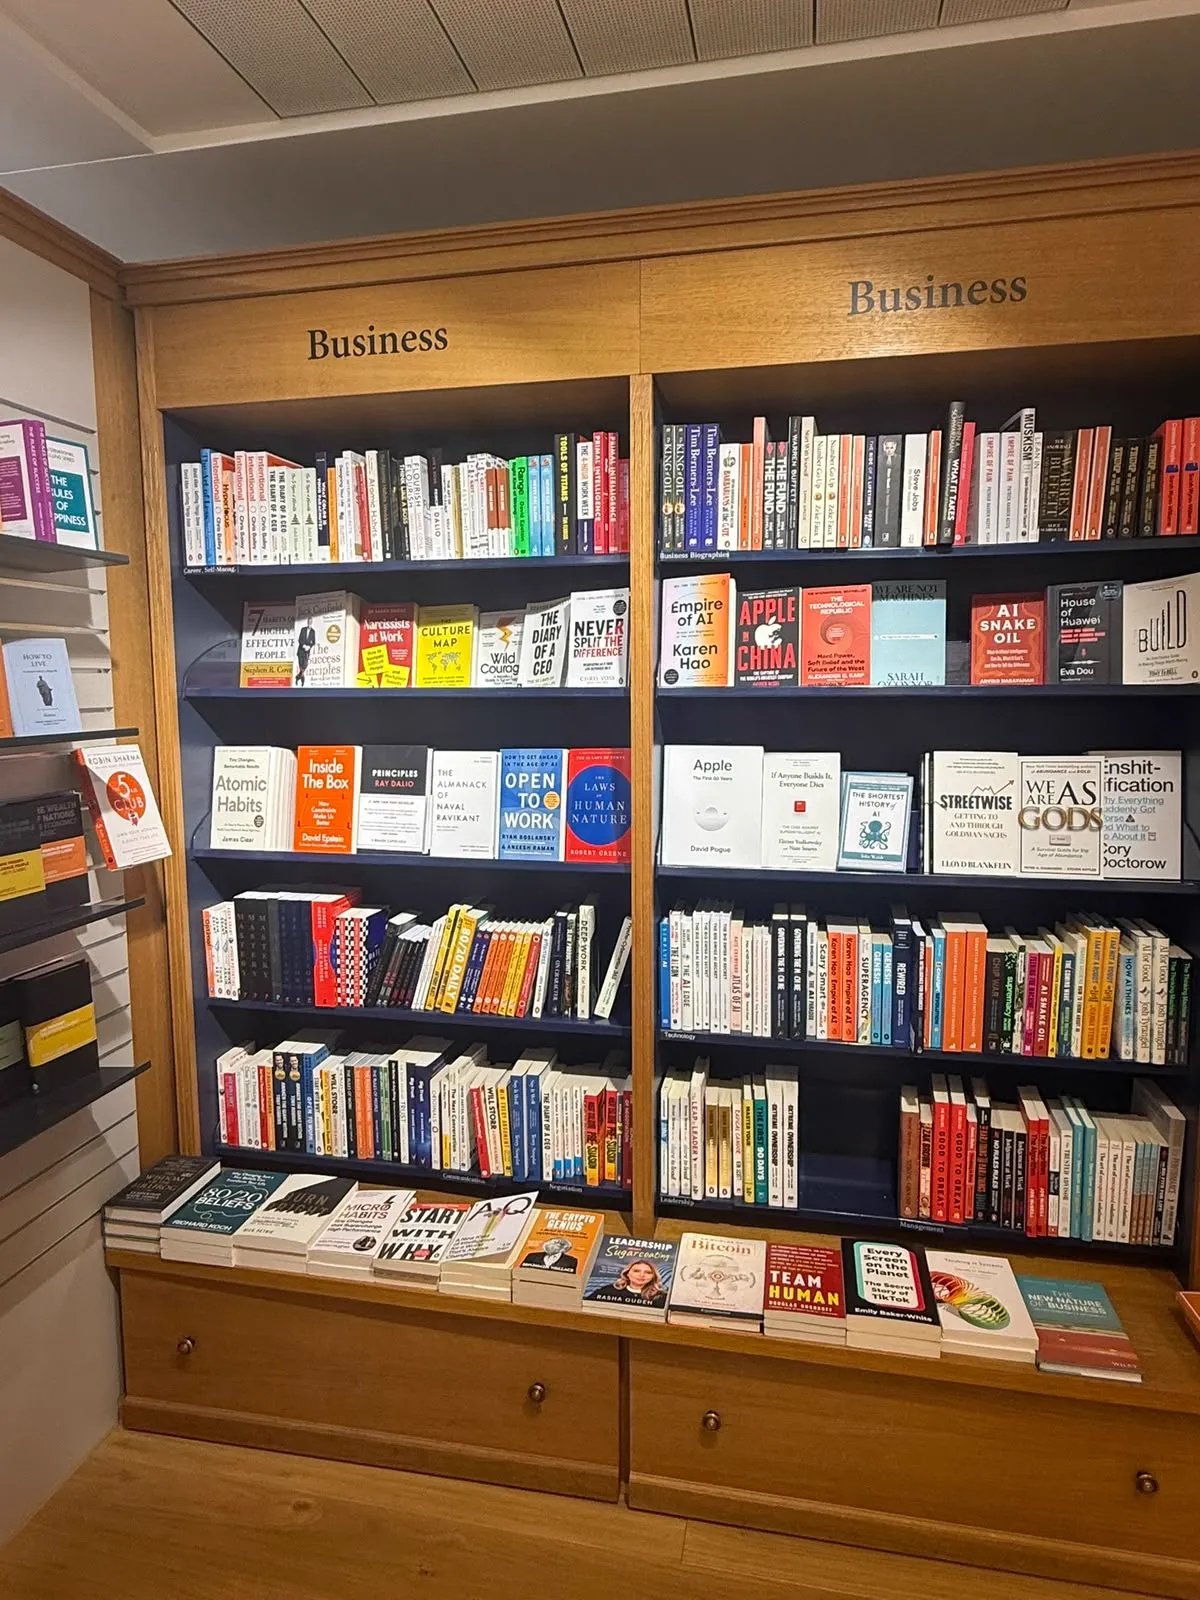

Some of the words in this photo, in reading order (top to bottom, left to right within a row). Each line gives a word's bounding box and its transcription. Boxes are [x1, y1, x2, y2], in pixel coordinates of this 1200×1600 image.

[846, 275, 1027, 317] Business
[307, 326, 448, 361] Business
[706, 426, 718, 447] Tim
[1022, 413, 1034, 462] MUSKISM
[560, 462, 568, 473] OF
[776, 456, 787, 482] THE
[950, 458, 960, 483] WHAT
[51, 475, 68, 486] THE
[258, 456, 268, 502] Intentional
[517, 467, 526, 496] Range
[706, 449, 717, 506] Berners-Lee
[913, 468, 922, 492] Steve
[950, 486, 957, 494] IT
[776, 482, 787, 514] FUND
[912, 492, 920, 512] Jobs
[56, 501, 68, 510] OF
[948, 494, 957, 521] TAKES
[54, 513, 86, 526] PPINESS
[690, 551, 730, 560] Biographies
[671, 598, 724, 616] Empire
[809, 602, 865, 610] TECHNOLOGICAL
[1060, 598, 1096, 608] House
[739, 597, 796, 626] APPLE
[996, 604, 1019, 617] AI
[1060, 608, 1072, 616] of
[364, 619, 410, 630] Narcissists
[540, 610, 560, 626] THE
[678, 614, 693, 626] of
[696, 614, 714, 626] AI
[1060, 616, 1101, 626] Huawei
[1138, 590, 1187, 653] BUILD
[421, 625, 471, 637] CULTURE
[574, 618, 624, 636] NEVER
[980, 619, 1036, 632] SNAKE
[368, 633, 378, 642] at
[380, 631, 404, 642] Work
[532, 625, 562, 644] DIARY
[574, 636, 602, 648] SPLIT
[604, 634, 623, 647] THE
[994, 633, 1022, 644] OIL
[433, 638, 458, 648] MAP
[255, 651, 286, 659] PEOPLE
[534, 645, 546, 660] OF
[548, 644, 556, 657] A
[574, 646, 623, 658] DIFFERENCE
[672, 644, 718, 656] Karen
[737, 642, 796, 671] CHINA
[490, 652, 516, 664] Wild
[680, 658, 710, 670] Hao
[480, 664, 520, 676] Courag
[532, 659, 552, 676] CEO
[1060, 668, 1075, 676] Eva
[1076, 668, 1094, 676] Dou
[888, 673, 924, 681] SARAH
[88, 755, 112, 766] ROBIN
[112, 753, 140, 764] SHARMA
[308, 758, 344, 774] Inside
[372, 768, 418, 778] PRINCIPLES
[438, 769, 453, 777] THE
[693, 760, 733, 773] Apple
[118, 774, 130, 798] 5
[215, 775, 267, 792] Atomic
[302, 774, 324, 789] The
[325, 774, 350, 790] Box
[374, 780, 389, 788] RAY
[390, 780, 415, 788] DALIO
[437, 780, 487, 788] ALMANACK
[505, 772, 555, 788] OPEN
[584, 782, 616, 791] LAWS
[779, 781, 808, 790] Everyone
[1104, 778, 1174, 793] ification
[1026, 780, 1055, 794] WE
[1058, 781, 1097, 806] AS
[518, 792, 540, 808] TO
[867, 792, 904, 800] SHORTEST
[940, 794, 1012, 811] STREETWISE
[1026, 794, 1055, 805] ARE
[113, 799, 144, 812] CLUB
[217, 796, 263, 813] Habits
[436, 803, 465, 811] NAVAL
[574, 801, 626, 811] HUMAN
[436, 814, 480, 822] RAVIKANT
[504, 812, 554, 829] WORK
[572, 814, 627, 824] NATURE
[1018, 806, 1104, 832] GODS
[861, 957, 869, 1020] SUPERAGENCY
[1040, 986, 1048, 994] AI
[1125, 979, 1132, 988] AI
[1039, 997, 1048, 1025] SNAKE
[664, 1032, 696, 1041] Technology
[488, 1105, 497, 1130] STORR
[955, 1163, 962, 1175] TO
[201, 1187, 263, 1201] 80/20
[954, 1179, 962, 1210] GREAT
[195, 1197, 255, 1210] BELIEFS
[346, 1203, 391, 1212] MICRO
[660, 1196, 695, 1206] Leadership
[339, 1211, 388, 1220] HABITS
[400, 1208, 464, 1225] START
[544, 1212, 560, 1221] THE
[562, 1212, 596, 1223] CRYPTO
[172, 1220, 204, 1229] RICHARD
[205, 1223, 233, 1232] KOCH
[546, 1220, 584, 1231] GENIUS
[900, 1222, 944, 1233] Management
[392, 1229, 456, 1238] WITH
[609, 1237, 673, 1251] LEADERSHIP
[692, 1240, 751, 1255] Bitcoin
[378, 1243, 445, 1260] WHY
[605, 1245, 671, 1261] Sugarcoating
[867, 1248, 903, 1257] Every
[864, 1255, 908, 1264] Screen
[886, 1262, 908, 1271] the
[770, 1270, 821, 1289] TEAM
[866, 1268, 909, 1279] Planet
[769, 1285, 839, 1306] HUMAN
[871, 1294, 910, 1304] TikTok
[1028, 1294, 1053, 1302] NEW
[1056, 1296, 1103, 1308] NATURE
[1030, 1300, 1045, 1308] OF
[1047, 1301, 1108, 1315] BUSINESS
[854, 1307, 878, 1316] Emily
[880, 1310, 933, 1323] Baker-White
